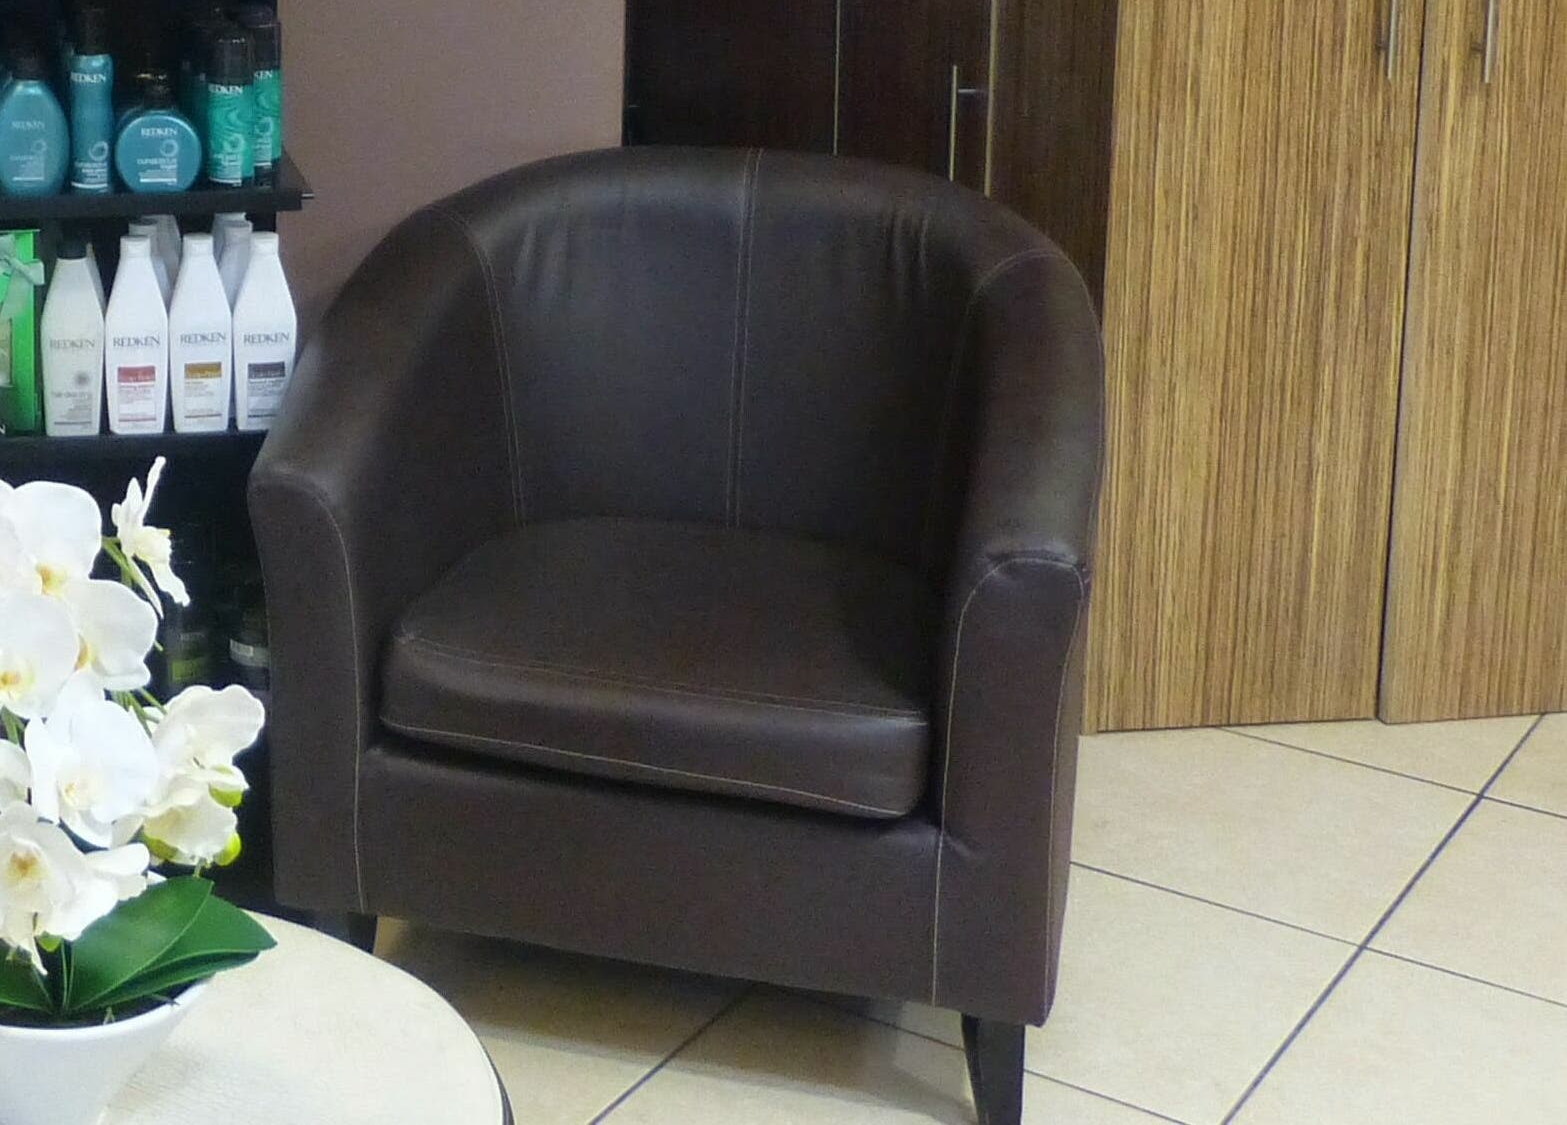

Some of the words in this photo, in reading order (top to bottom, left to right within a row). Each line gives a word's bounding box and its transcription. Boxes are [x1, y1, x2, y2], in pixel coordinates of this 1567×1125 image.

[140, 127, 178, 137] REDKEN
[49, 339, 96, 349] REDKEN
[113, 336, 160, 348] REDKEN
[180, 332, 227, 345] REDKEN
[244, 332, 290, 344] REDKEN
